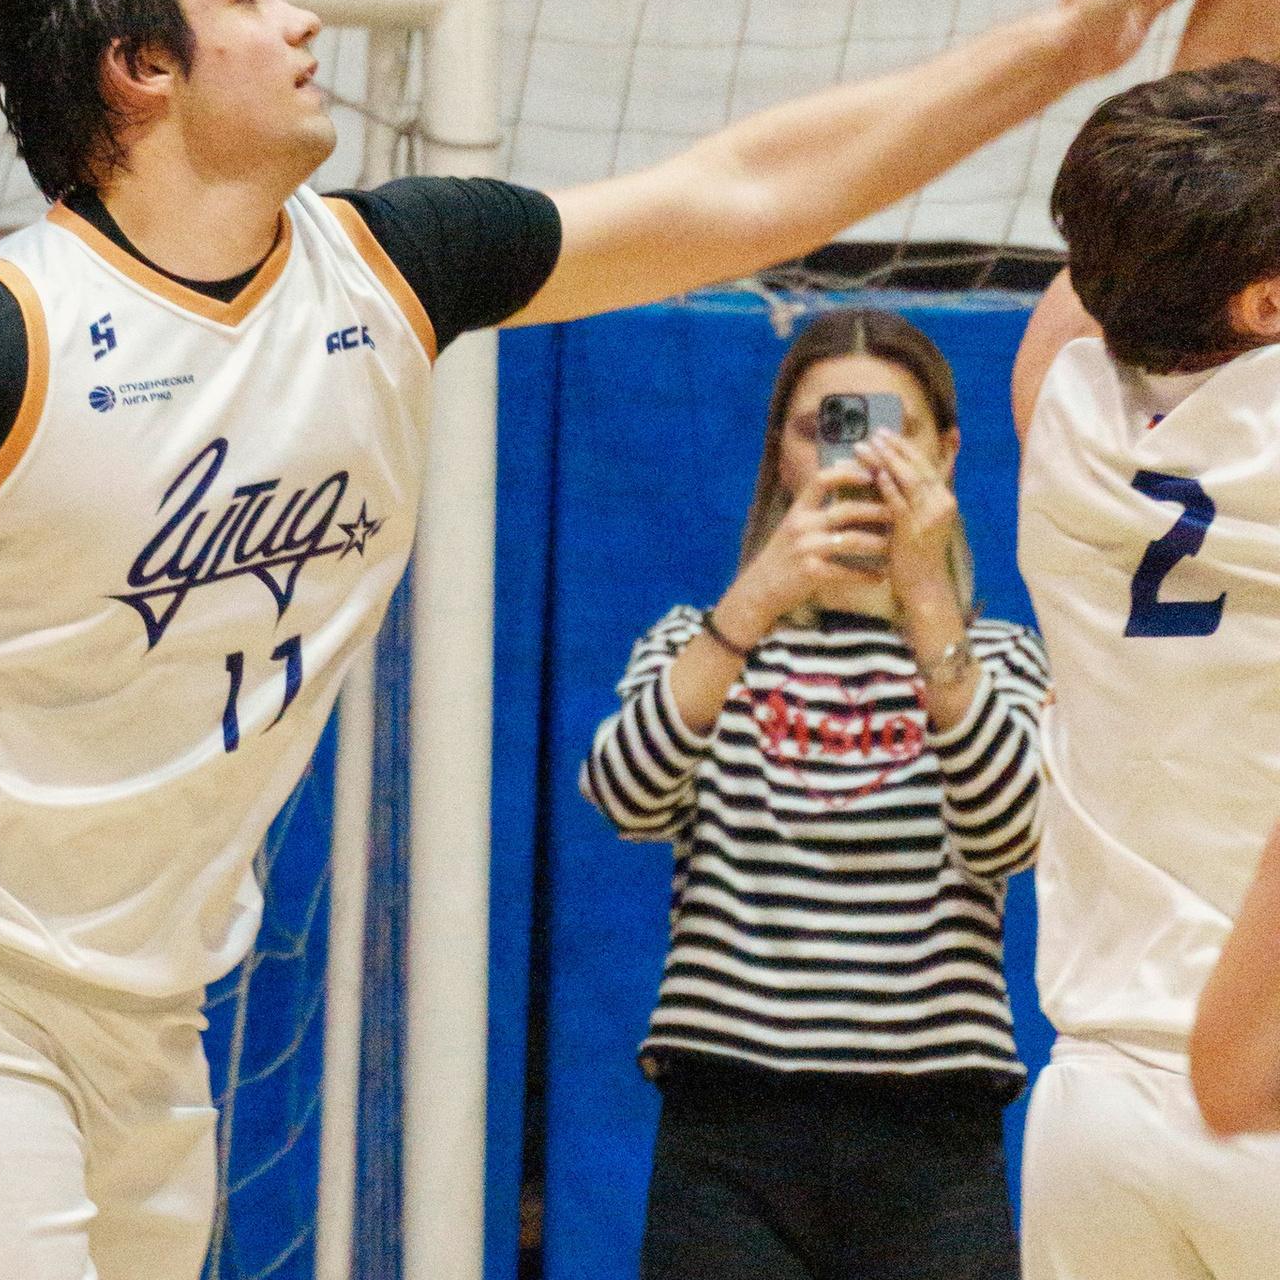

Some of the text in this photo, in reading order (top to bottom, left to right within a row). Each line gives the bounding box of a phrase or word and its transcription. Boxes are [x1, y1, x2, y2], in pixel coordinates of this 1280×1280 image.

[118, 374, 195, 394] СТУДЕНЧЕСКАЯ
[1122, 469, 1227, 638] 2
[222, 634, 303, 753] 11
